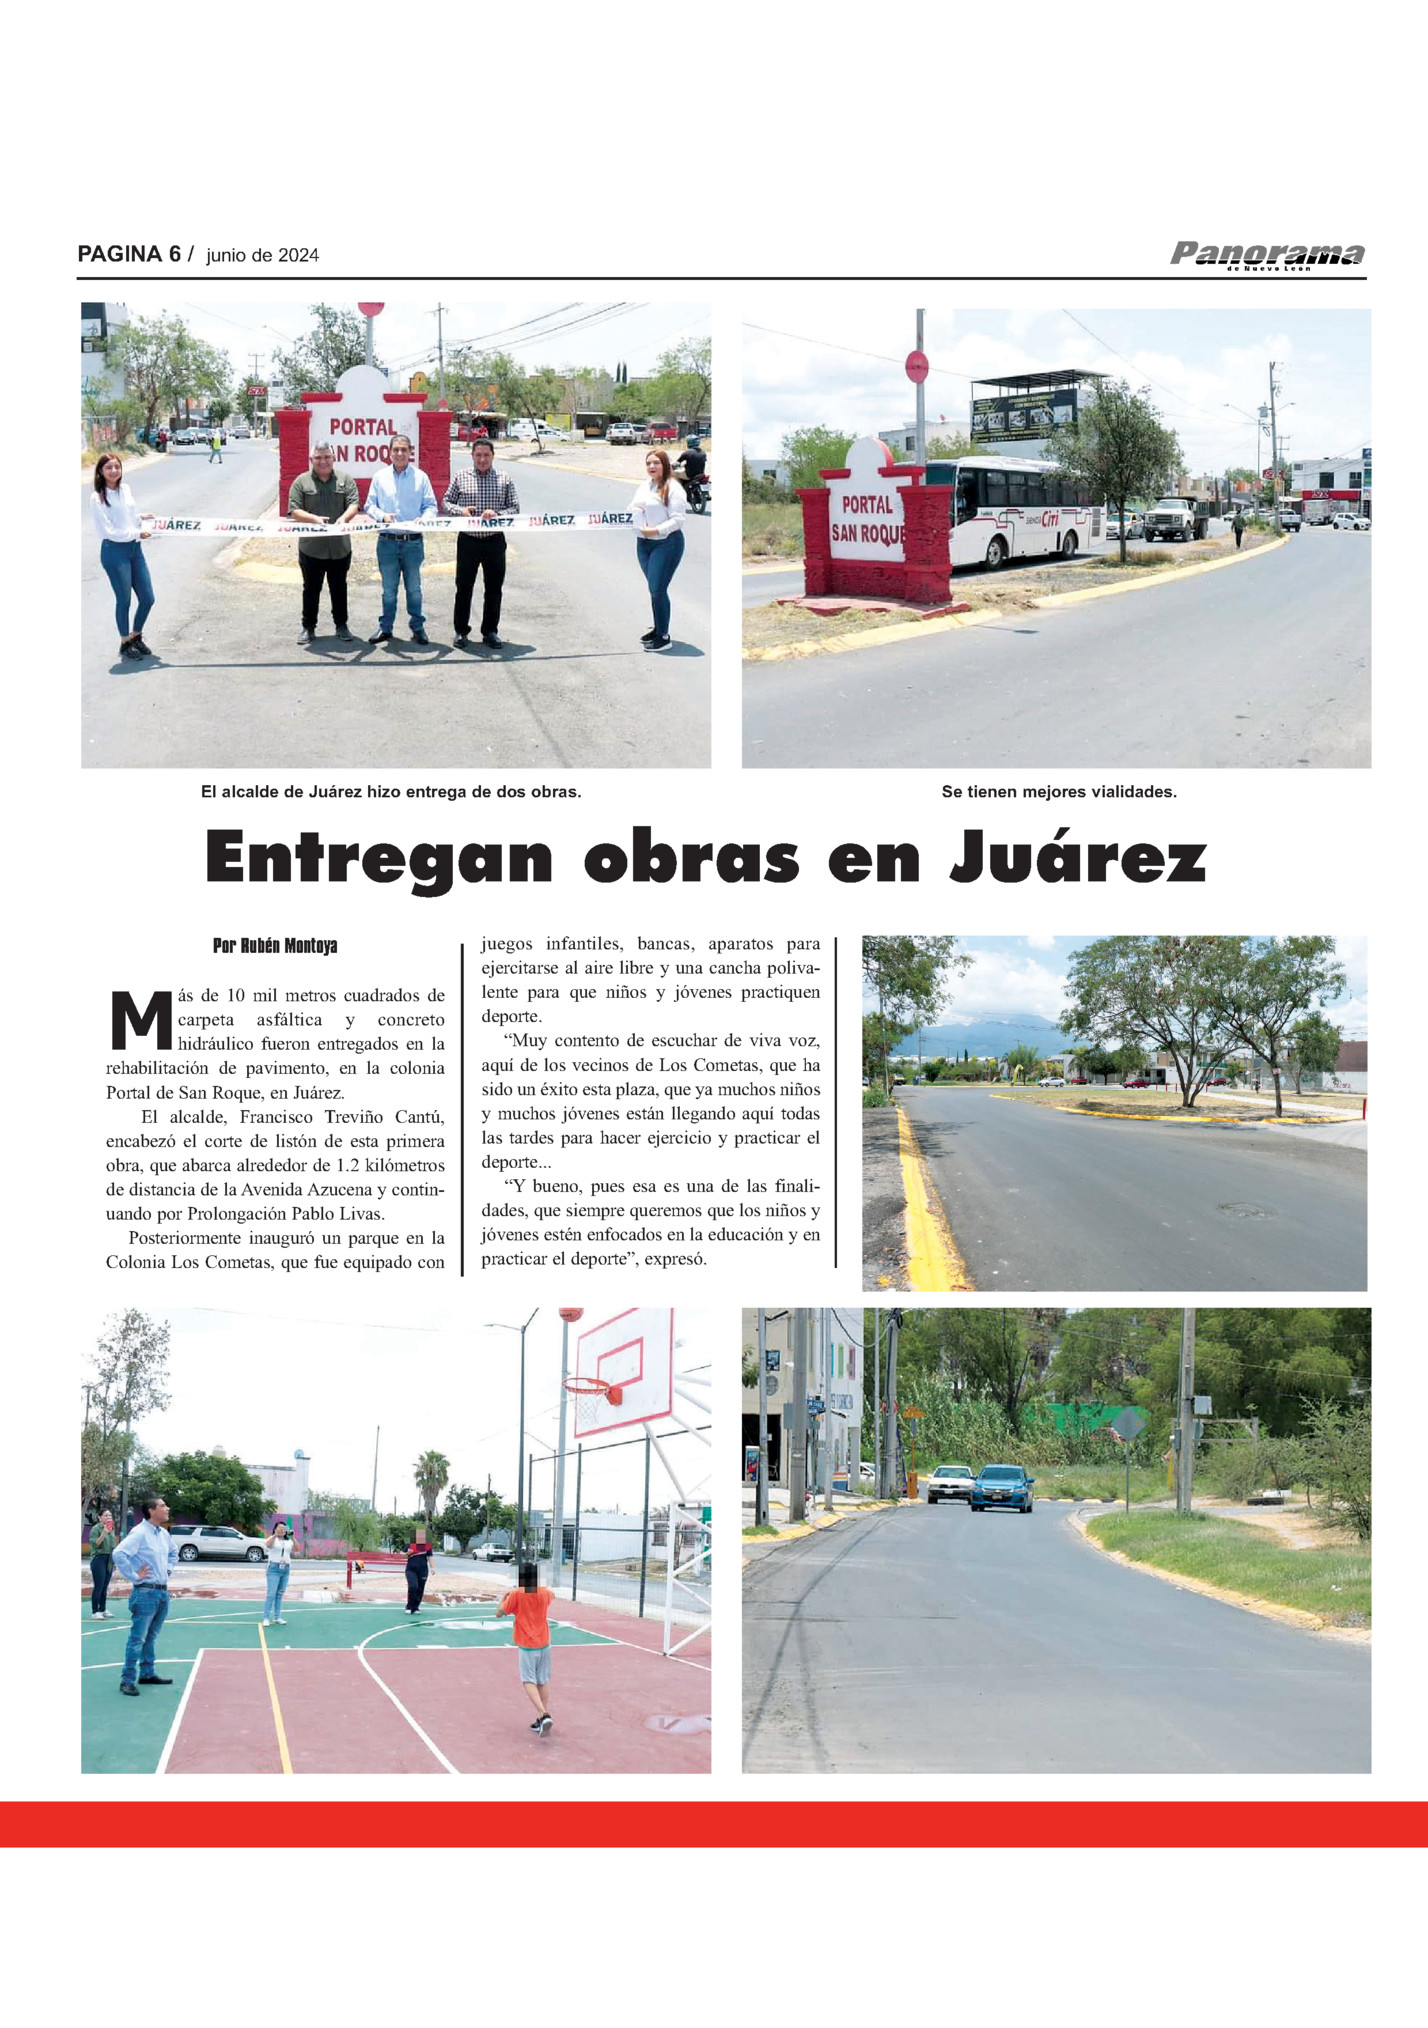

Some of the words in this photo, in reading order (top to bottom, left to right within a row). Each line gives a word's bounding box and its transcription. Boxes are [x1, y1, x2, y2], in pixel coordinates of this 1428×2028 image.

[78, 244, 163, 263] PAGINA
[169, 244, 181, 263] 6
[187, 244, 195, 263] /
[205, 247, 247, 267] junio
[251, 247, 273, 263] de
[278, 247, 320, 263] 2024
[1169, 240, 1366, 266] Panorama
[1284, 264, 1311, 272] León
[330, 418, 397, 435] PORTAL
[843, 496, 893, 514] PORTAL
[152, 517, 202, 531] JUÁREZ
[528, 513, 576, 526] JUÁREZ
[587, 511, 635, 525] JUÁREZ
[832, 524, 857, 542] SAN
[201, 784, 217, 798] El
[221, 784, 279, 798] alcalde
[283, 784, 304, 798] de
[308, 784, 363, 798] Juárez
[367, 784, 401, 798] hizo
[406, 785, 467, 802] entrega
[471, 784, 492, 798] de
[496, 784, 526, 798] dos
[531, 784, 582, 798] obras.
[941, 784, 963, 798] Se
[967, 784, 1017, 798] tienen
[1022, 784, 1087, 802] mejores
[1091, 784, 1177, 798] vialidades.
[206, 828, 552, 899] Entregan
[584, 825, 800, 884] obras
[828, 842, 920, 884] en
[948, 826, 1208, 884] Juárez
[213, 937, 237, 954] Por
[240, 936, 281, 954] Rubén
[284, 937, 338, 957] Montoya
[479, 935, 533, 954] juegos
[547, 935, 624, 952] infantiles,
[637, 936, 695, 951] bancas,
[708, 938, 774, 954] aparatos
[787, 940, 821, 954] para
[201, 987, 219, 1002] de
[229, 988, 245, 1002] 10
[253, 987, 277, 1002] mil
[285, 990, 337, 1002] metros
[343, 987, 420, 1002] cuadrados
[427, 987, 446, 1002] de
[482, 984, 519, 999] lente
[527, 988, 560, 1003] para
[569, 988, 597, 1003] que
[606, 984, 647, 999] niños
[655, 988, 666, 1003] y
[673, 984, 733, 1003] jóvenes
[741, 984, 821, 1003] practiquen
[178, 1014, 234, 1031] carpeta
[256, 1011, 323, 1027] asfáltica
[345, 1016, 355, 1031] y
[377, 1014, 445, 1027] concreto
[481, 1008, 542, 1027] deporte.
[178, 1036, 254, 1051] hidráulico
[261, 1035, 310, 1051] fueron
[317, 1036, 399, 1055] entregados
[406, 1040, 424, 1051] en
[432, 1036, 445, 1051] la
[554, 1035, 620, 1047] contento
[626, 1032, 645, 1047] de
[651, 1032, 718, 1047] escuchar
[724, 1032, 742, 1047] de
[750, 1032, 782, 1047] viva
[789, 1036, 821, 1048] voz,
[106, 1085, 151, 1100] Portal
[156, 1085, 174, 1100] de
[179, 1085, 207, 1100] San
[212, 1085, 265, 1104] Roque,
[270, 1089, 288, 1100] en
[293, 1085, 345, 1100] Juárez.
[482, 1081, 513, 1096] sido
[517, 1085, 536, 1096] un
[540, 1081, 578, 1096] éxito
[582, 1084, 612, 1096] esta
[615, 1081, 660, 1100] plaza,
[664, 1085, 692, 1100] que
[695, 1085, 713, 1100] ya
[718, 1081, 776, 1096] muchos
[780, 1081, 821, 1096] niños
[141, 1109, 158, 1124] El
[169, 1109, 228, 1125] alcalde,
[240, 1109, 313, 1124] Francisco
[324, 1109, 384, 1124] Treviño
[395, 1109, 445, 1125] Cantú,
[106, 1157, 144, 1174] obra,
[149, 1162, 177, 1176] que
[182, 1157, 232, 1172] abarca
[236, 1157, 308, 1172] alrededor
[312, 1157, 331, 1172] de
[338, 1157, 359, 1172] 1.2
[365, 1157, 446, 1172] kilómetros
[481, 1154, 552, 1173] deporte...
[532, 1178, 583, 1194] bueno,
[591, 1182, 625, 1197] pues
[632, 1182, 657, 1193] esa
[663, 1182, 680, 1193] es
[686, 1182, 714, 1193] una
[721, 1178, 739, 1193] de
[747, 1178, 768, 1193] las
[775, 1178, 821, 1193] finali-
[106, 1206, 152, 1221] uando
[157, 1210, 183, 1225] por
[187, 1206, 287, 1225] Prolongación
[292, 1206, 335, 1221] Pablo
[340, 1206, 385, 1221] Livas.
[128, 1230, 242, 1245] Posteriormente
[249, 1230, 315, 1249] inauguró
[322, 1234, 341, 1245] un
[348, 1234, 399, 1249] parque
[406, 1234, 424, 1245] en
[432, 1230, 445, 1245] la
[479, 1226, 539, 1245] jóvenes
[543, 1227, 582, 1241] estén
[587, 1226, 663, 1241] enfocados
[667, 1231, 685, 1241] en
[690, 1226, 703, 1241] la
[707, 1226, 784, 1241] educación
[788, 1231, 798, 1245] y
[803, 1231, 820, 1241] en
[106, 1254, 166, 1269] Colonia
[171, 1254, 200, 1269] Los
[205, 1254, 275, 1270] Cometas,
[281, 1258, 309, 1273] que
[314, 1254, 338, 1269] fue
[343, 1254, 412, 1273] equipado
[417, 1258, 445, 1269] con
[481, 1251, 548, 1270] practicar
[552, 1251, 565, 1266] el
[644, 1251, 707, 1270] expresó.
